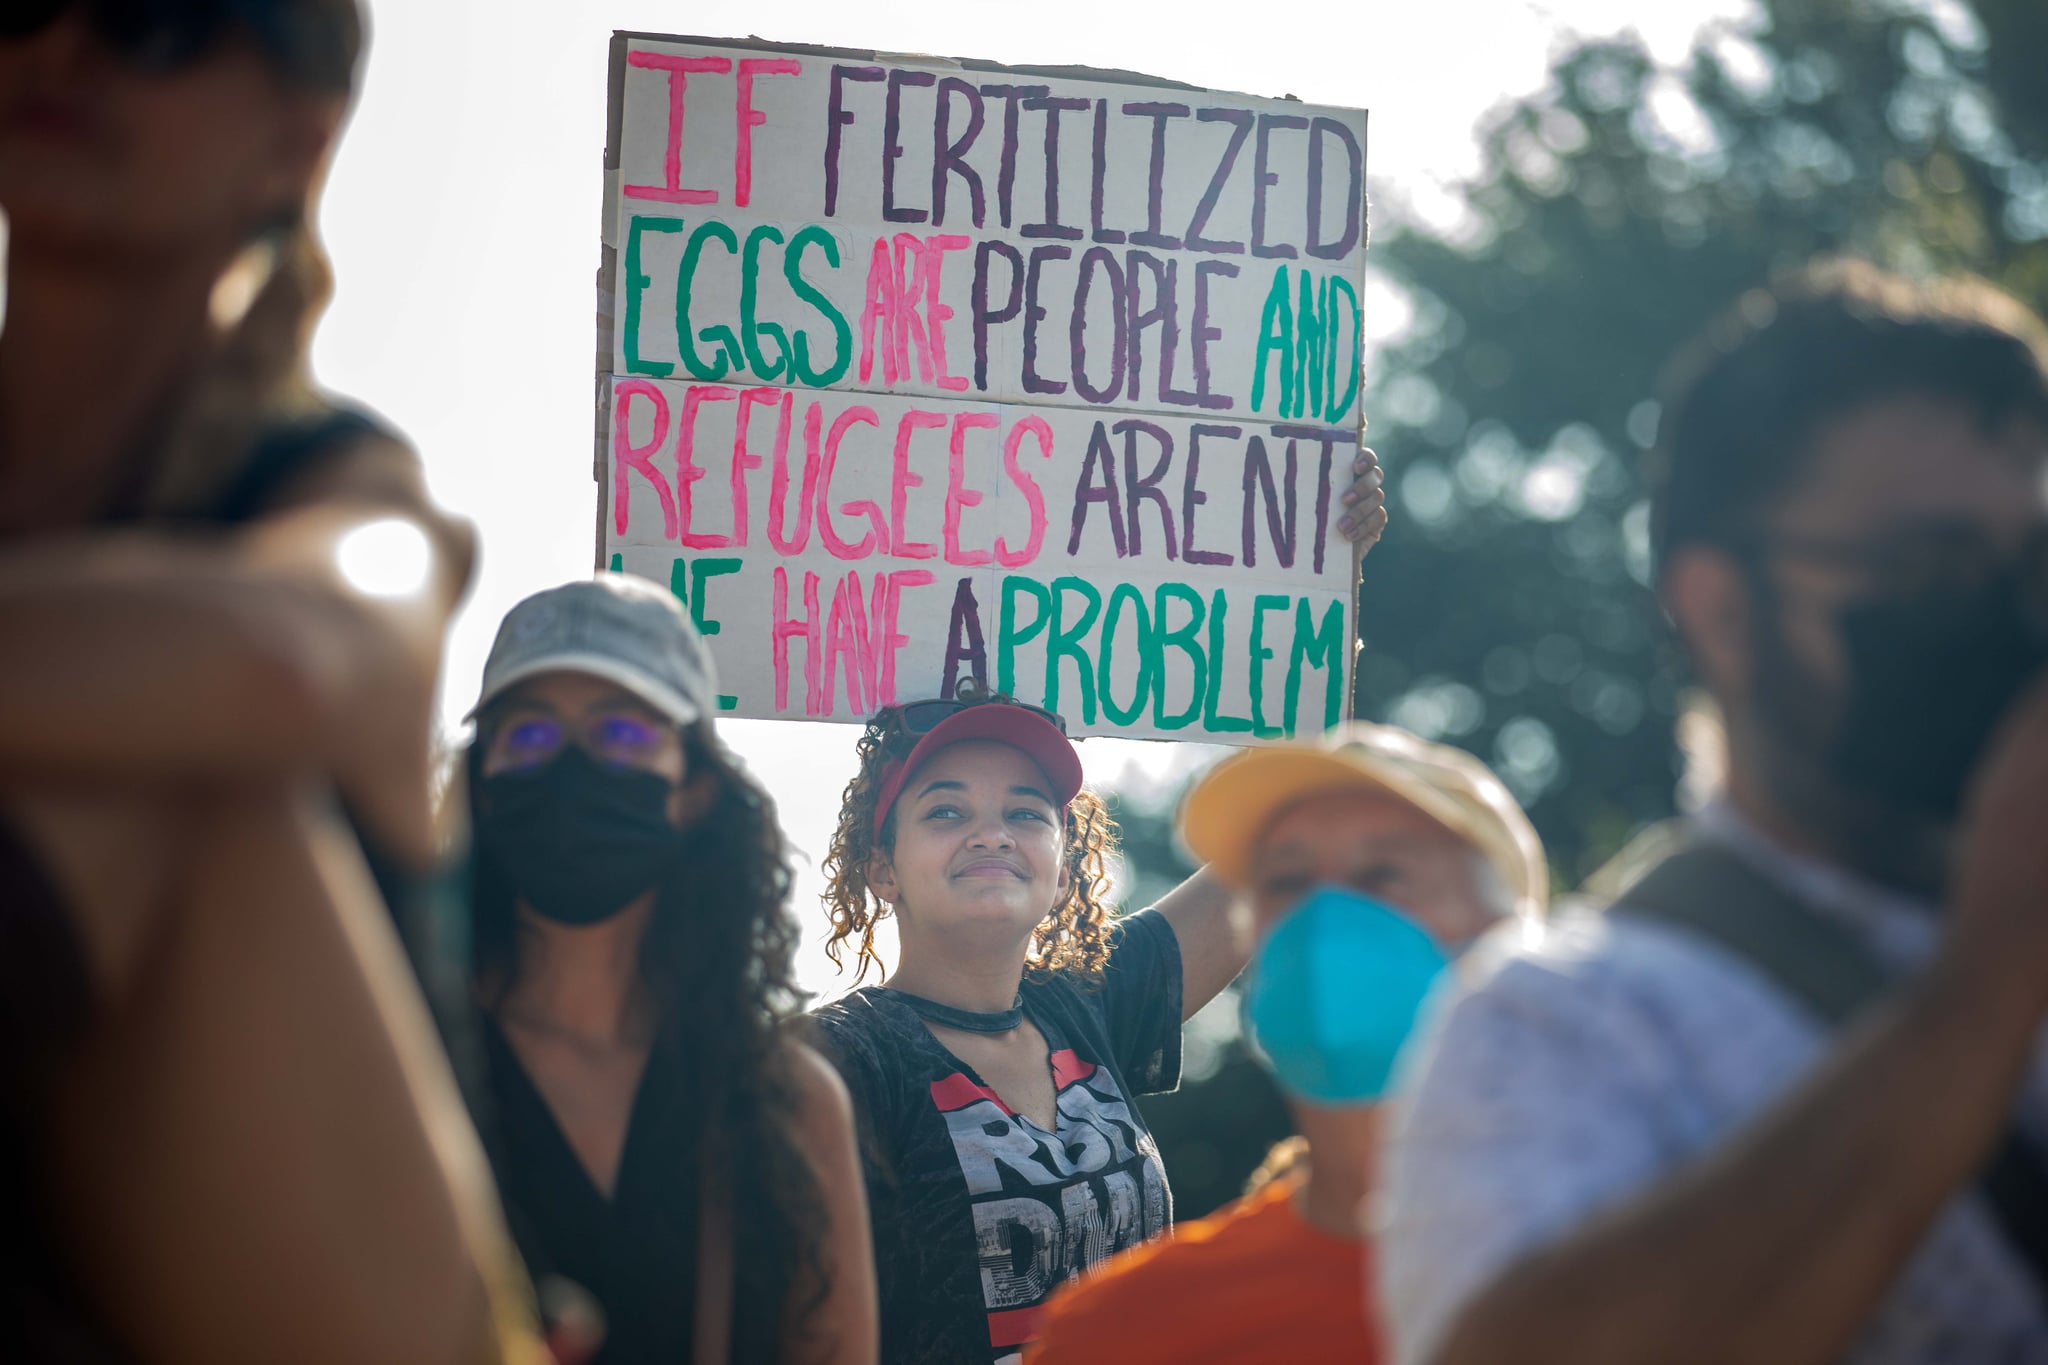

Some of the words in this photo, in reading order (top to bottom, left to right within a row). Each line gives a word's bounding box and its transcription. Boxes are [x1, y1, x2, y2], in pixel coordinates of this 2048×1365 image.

[623, 50, 801, 208] IF
[825, 64, 1363, 260] FERTILIZED
[624, 215, 853, 388] EGGS
[859, 232, 971, 391] ARE
[972, 239, 1240, 410] PEOPLE
[1251, 263, 1361, 421] AND
[614, 379, 1054, 568] REFUGEES
[1068, 418, 1356, 575] ARENT
[610, 553, 743, 710] E
[772, 566, 938, 716] HAVE
[941, 577, 988, 699] A
[998, 575, 1344, 740] PROBLEM
